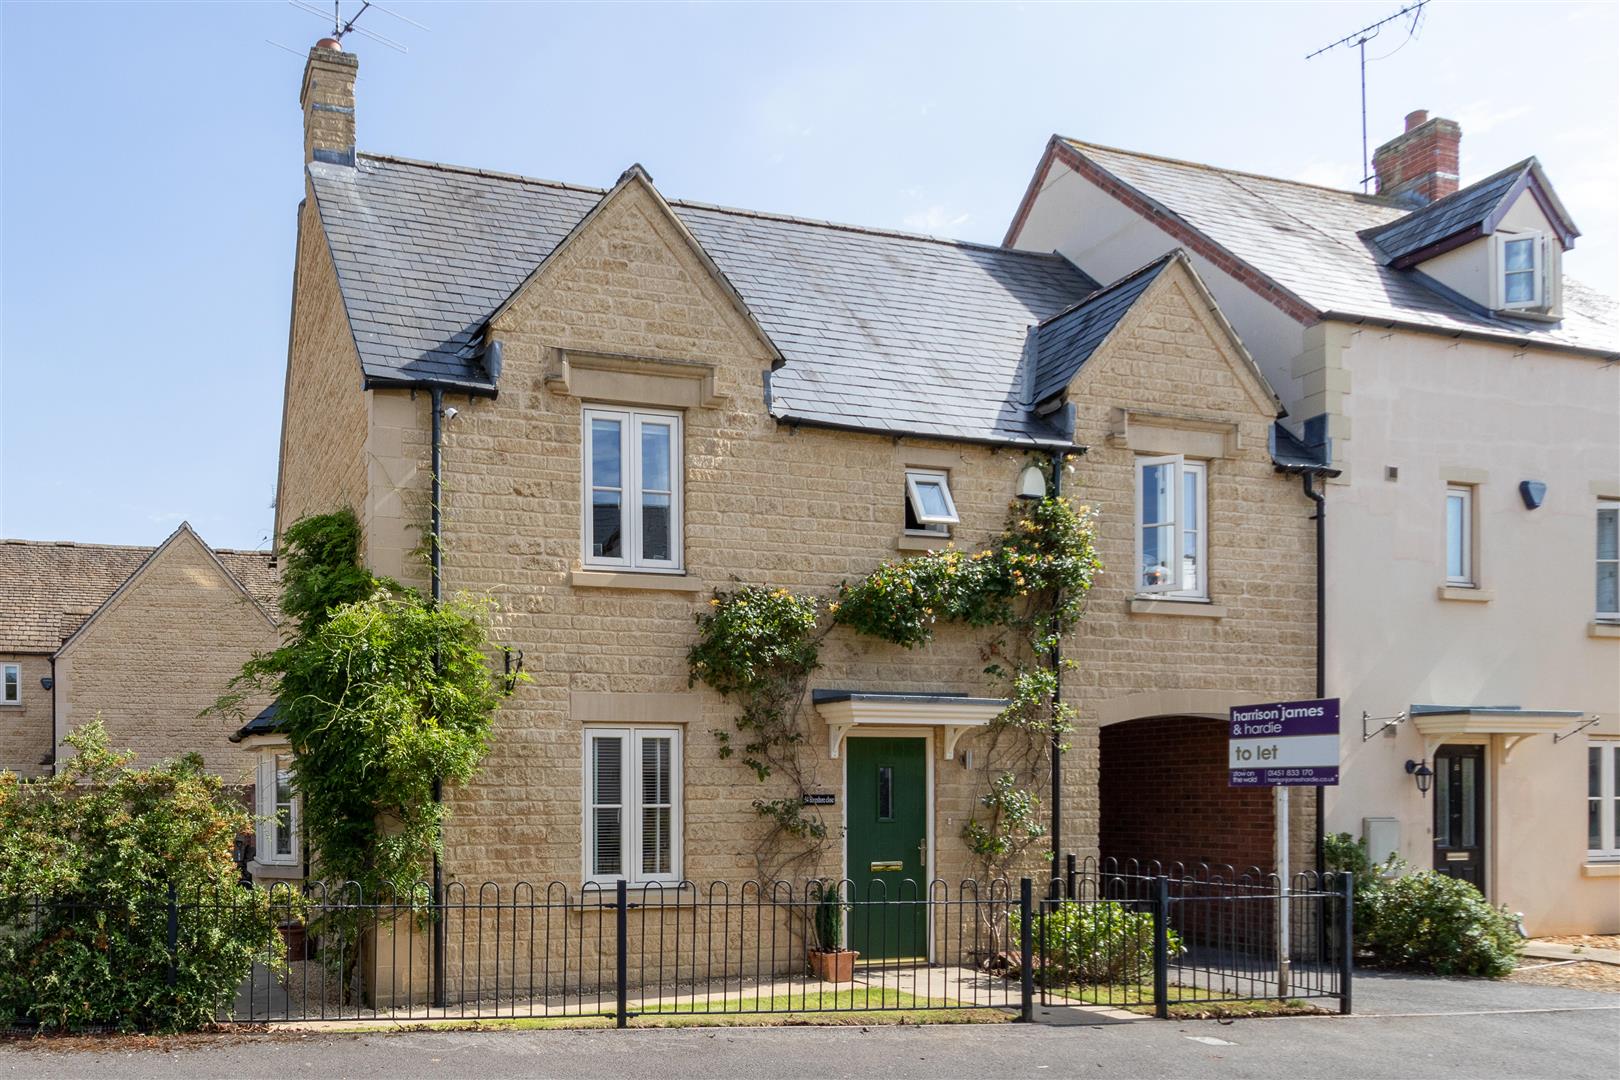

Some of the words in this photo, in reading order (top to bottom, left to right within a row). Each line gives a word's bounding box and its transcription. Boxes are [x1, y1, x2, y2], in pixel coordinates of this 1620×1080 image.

[1233, 709, 1279, 721] harrison
[1280, 706, 1324, 721] james
[1233, 724, 1242, 735] &
[1244, 722, 1282, 735] hardie
[1235, 746, 1252, 761] to
[1257, 744, 1278, 761] let
[1286, 769, 1300, 777] 833
